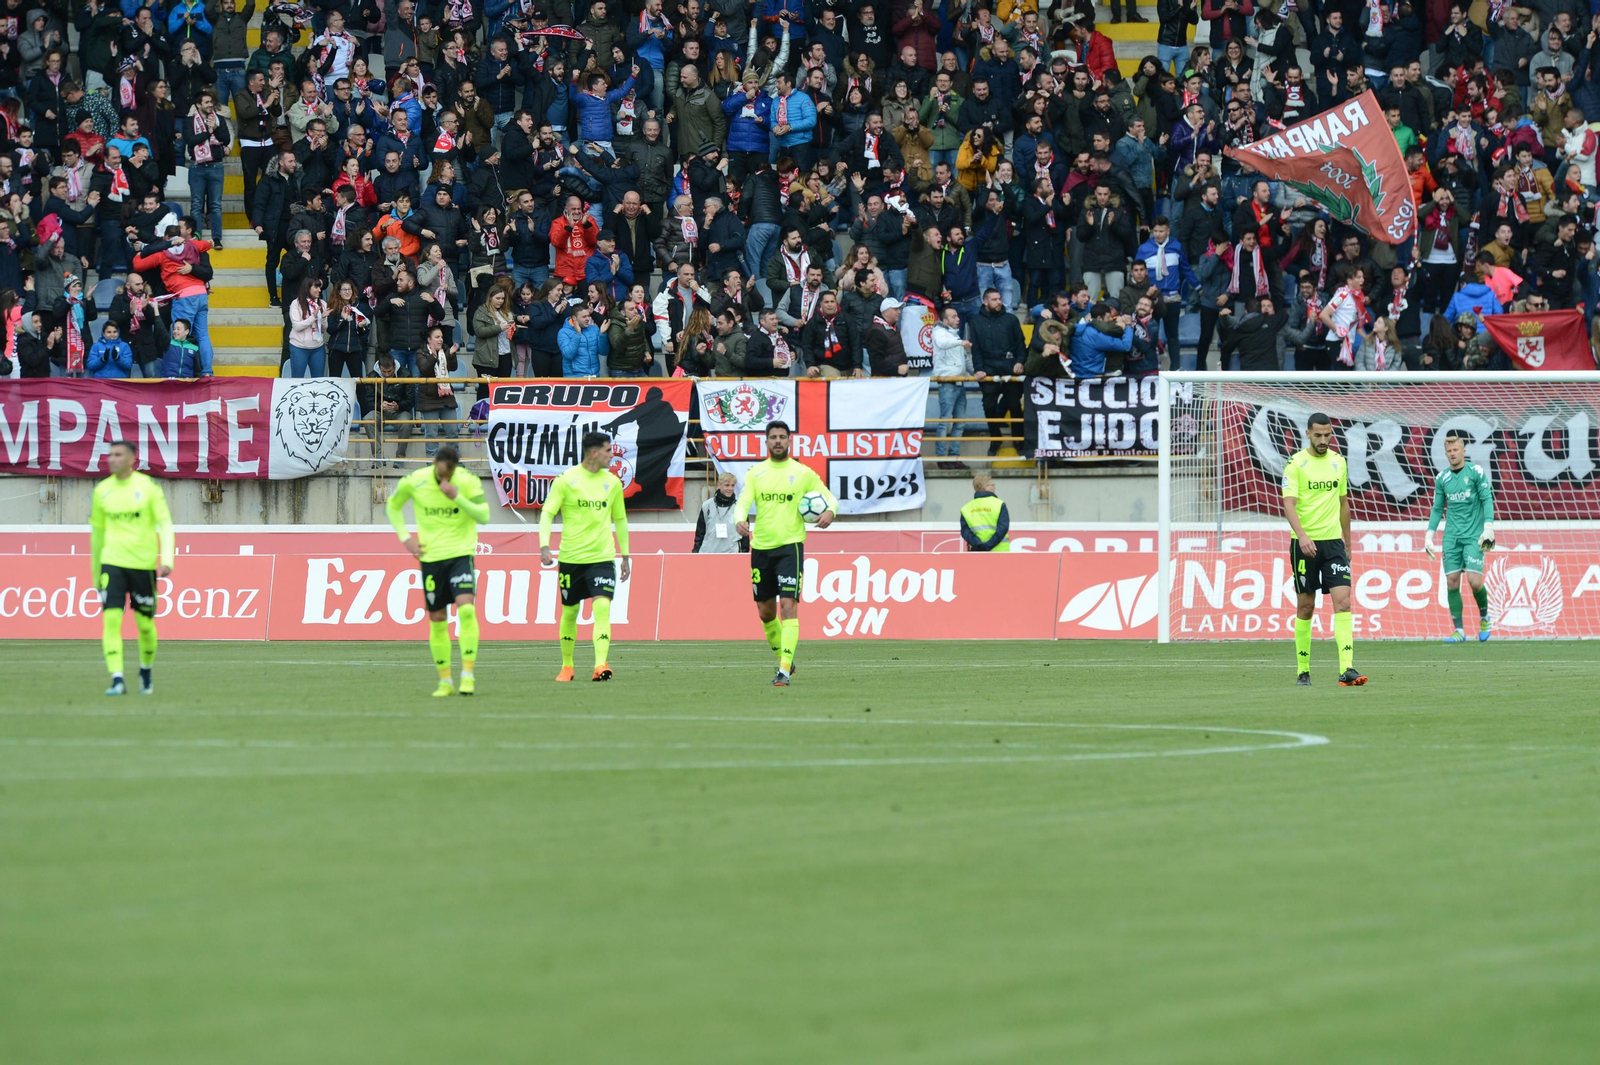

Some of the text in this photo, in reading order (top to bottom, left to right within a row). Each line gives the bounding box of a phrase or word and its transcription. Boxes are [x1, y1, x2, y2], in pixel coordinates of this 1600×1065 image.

[492, 384, 641, 408] GRUPO
[0, 394, 260, 477] MPANTE
[1036, 410, 1160, 450] EJIDO
[705, 431, 923, 458] CULTRALISTAS
[837, 472, 920, 500] 1923
[1308, 479, 1339, 491] tango
[577, 498, 608, 510] tango
[761, 492, 793, 504] tango
[1298, 559, 1307, 575] 4
[425, 575, 436, 592] 6
[559, 572, 571, 588] 21
[1182, 558, 1450, 609] Nakeel
[822, 606, 889, 637] SIN
